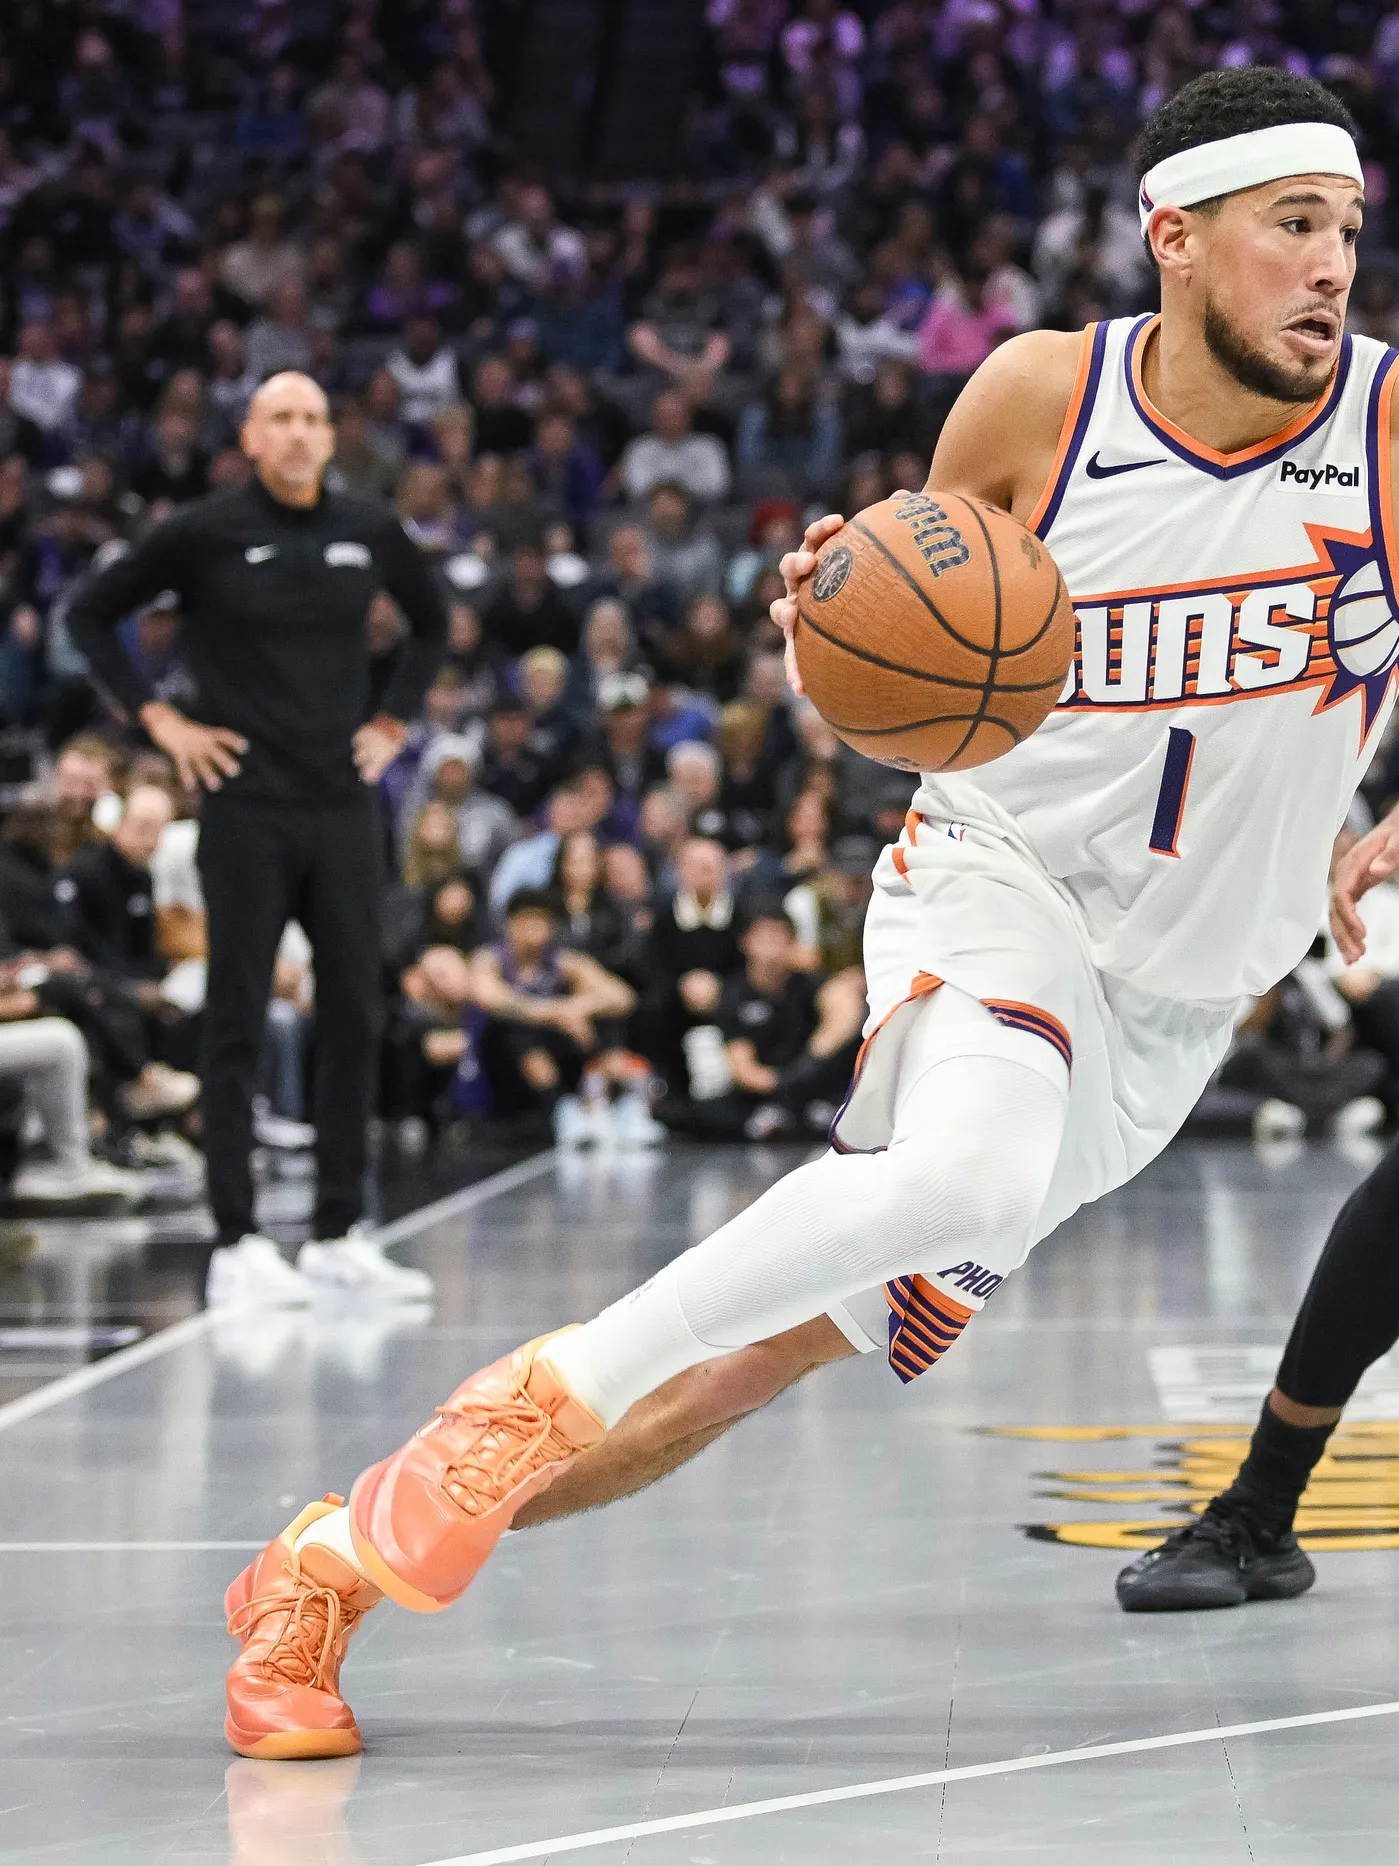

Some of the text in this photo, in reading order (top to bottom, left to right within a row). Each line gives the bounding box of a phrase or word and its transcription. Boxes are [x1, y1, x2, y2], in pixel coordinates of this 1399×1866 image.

[1280, 460, 1360, 490] PayPal
[1057, 583, 1316, 704] UNS
[1148, 726, 1197, 859] 1
[936, 1260, 1004, 1301] PHO
